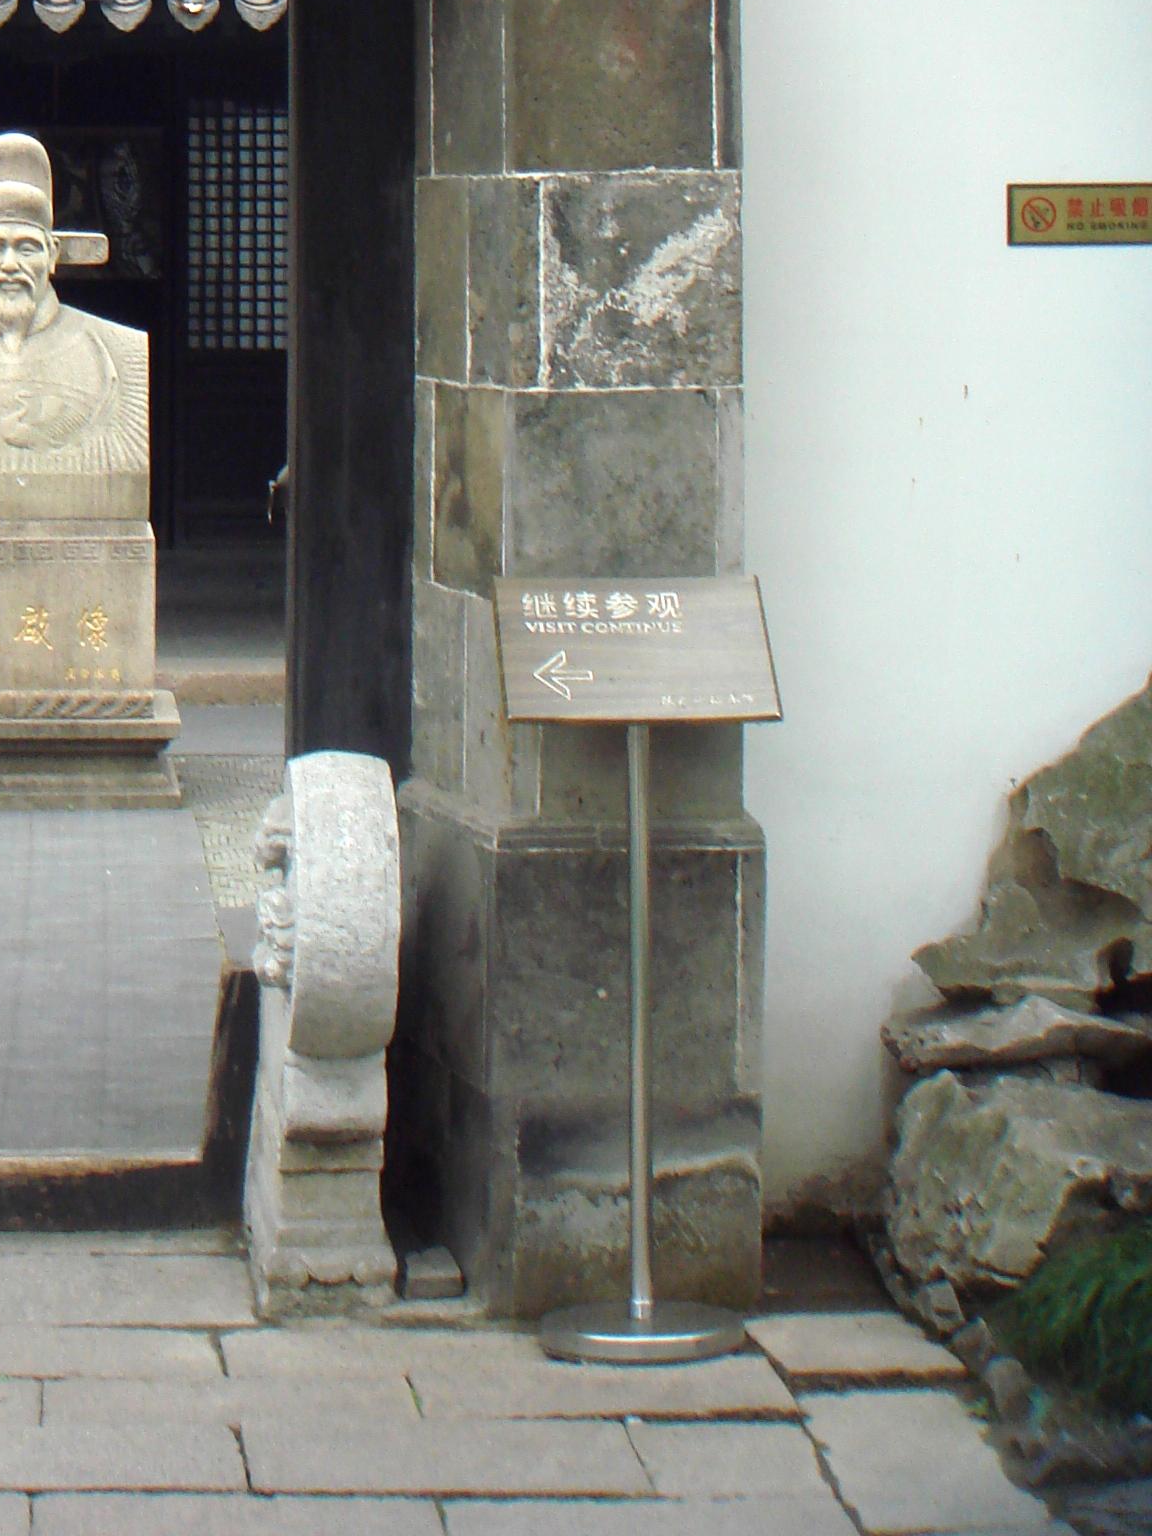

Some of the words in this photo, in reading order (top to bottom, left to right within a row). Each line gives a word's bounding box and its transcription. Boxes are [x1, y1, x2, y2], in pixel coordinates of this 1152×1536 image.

[521, 592, 683, 619] 继续参观
[524, 621, 577, 634] VISIT
[580, 621, 683, 634] CONTINUE
